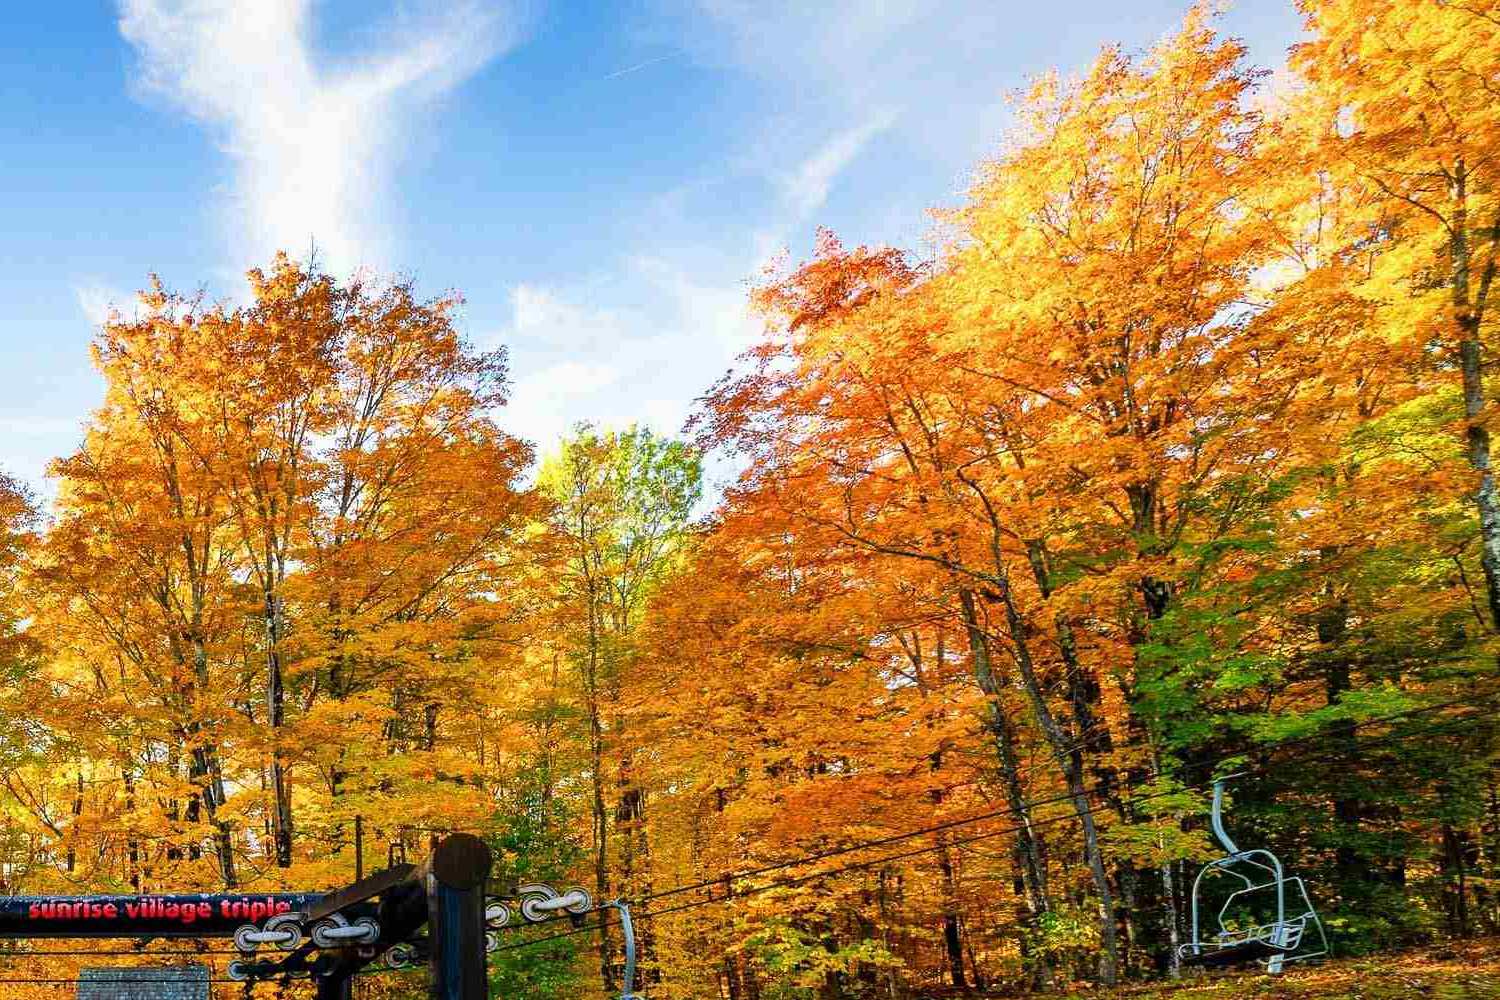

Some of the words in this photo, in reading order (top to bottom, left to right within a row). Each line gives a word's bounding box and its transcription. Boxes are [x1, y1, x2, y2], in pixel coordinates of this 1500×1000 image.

[29, 899, 117, 919] sunrise
[125, 897, 212, 923] village
[220, 895, 291, 923] triple
